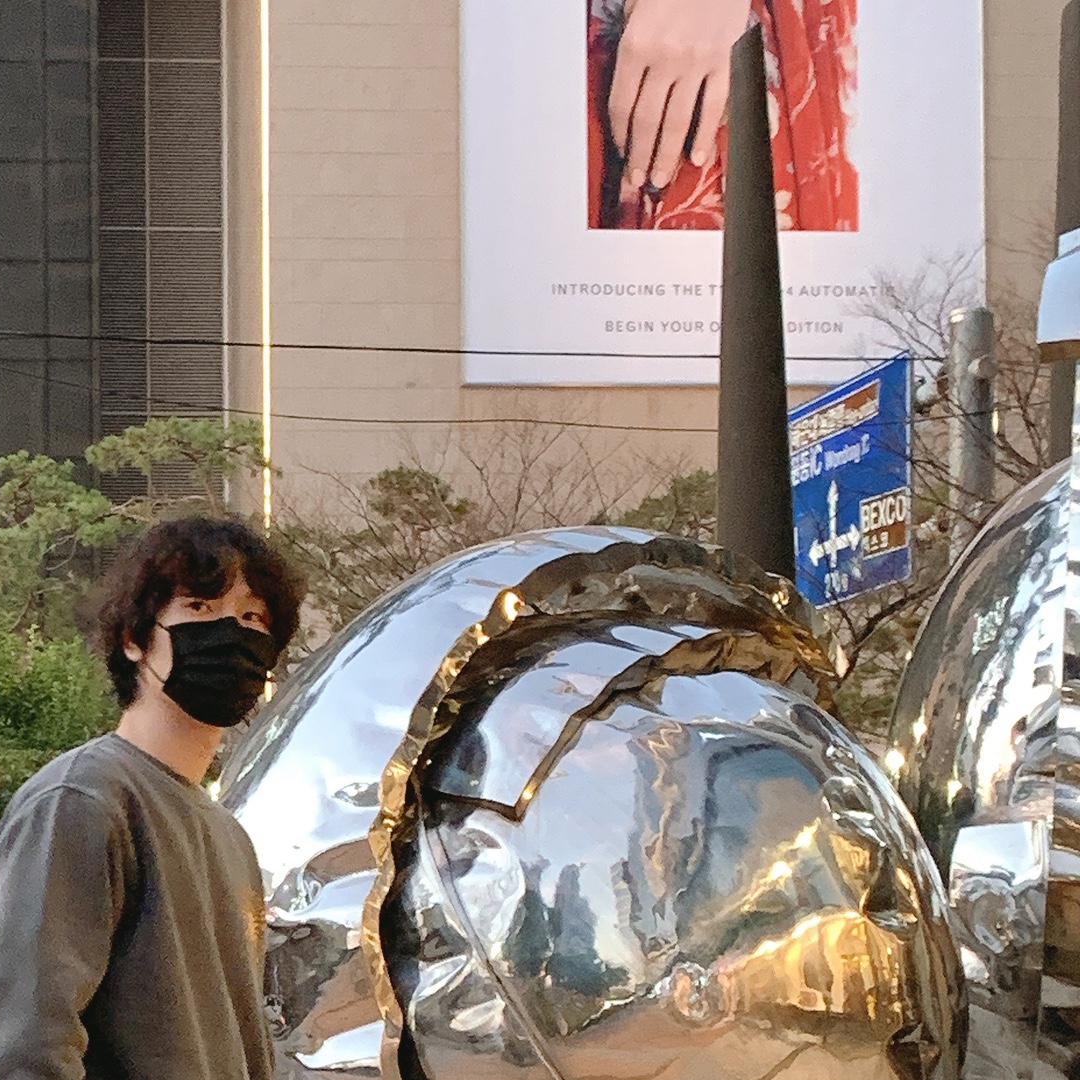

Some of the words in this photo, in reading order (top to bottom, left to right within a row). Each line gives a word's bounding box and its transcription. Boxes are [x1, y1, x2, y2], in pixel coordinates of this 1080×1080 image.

[551, 283, 666, 297] INTRODUCING
[672, 284, 703, 297] THE
[604, 320, 655, 333] BEGIN
[660, 320, 704, 333] YOUR
[861, 494, 907, 534] BEXCO
